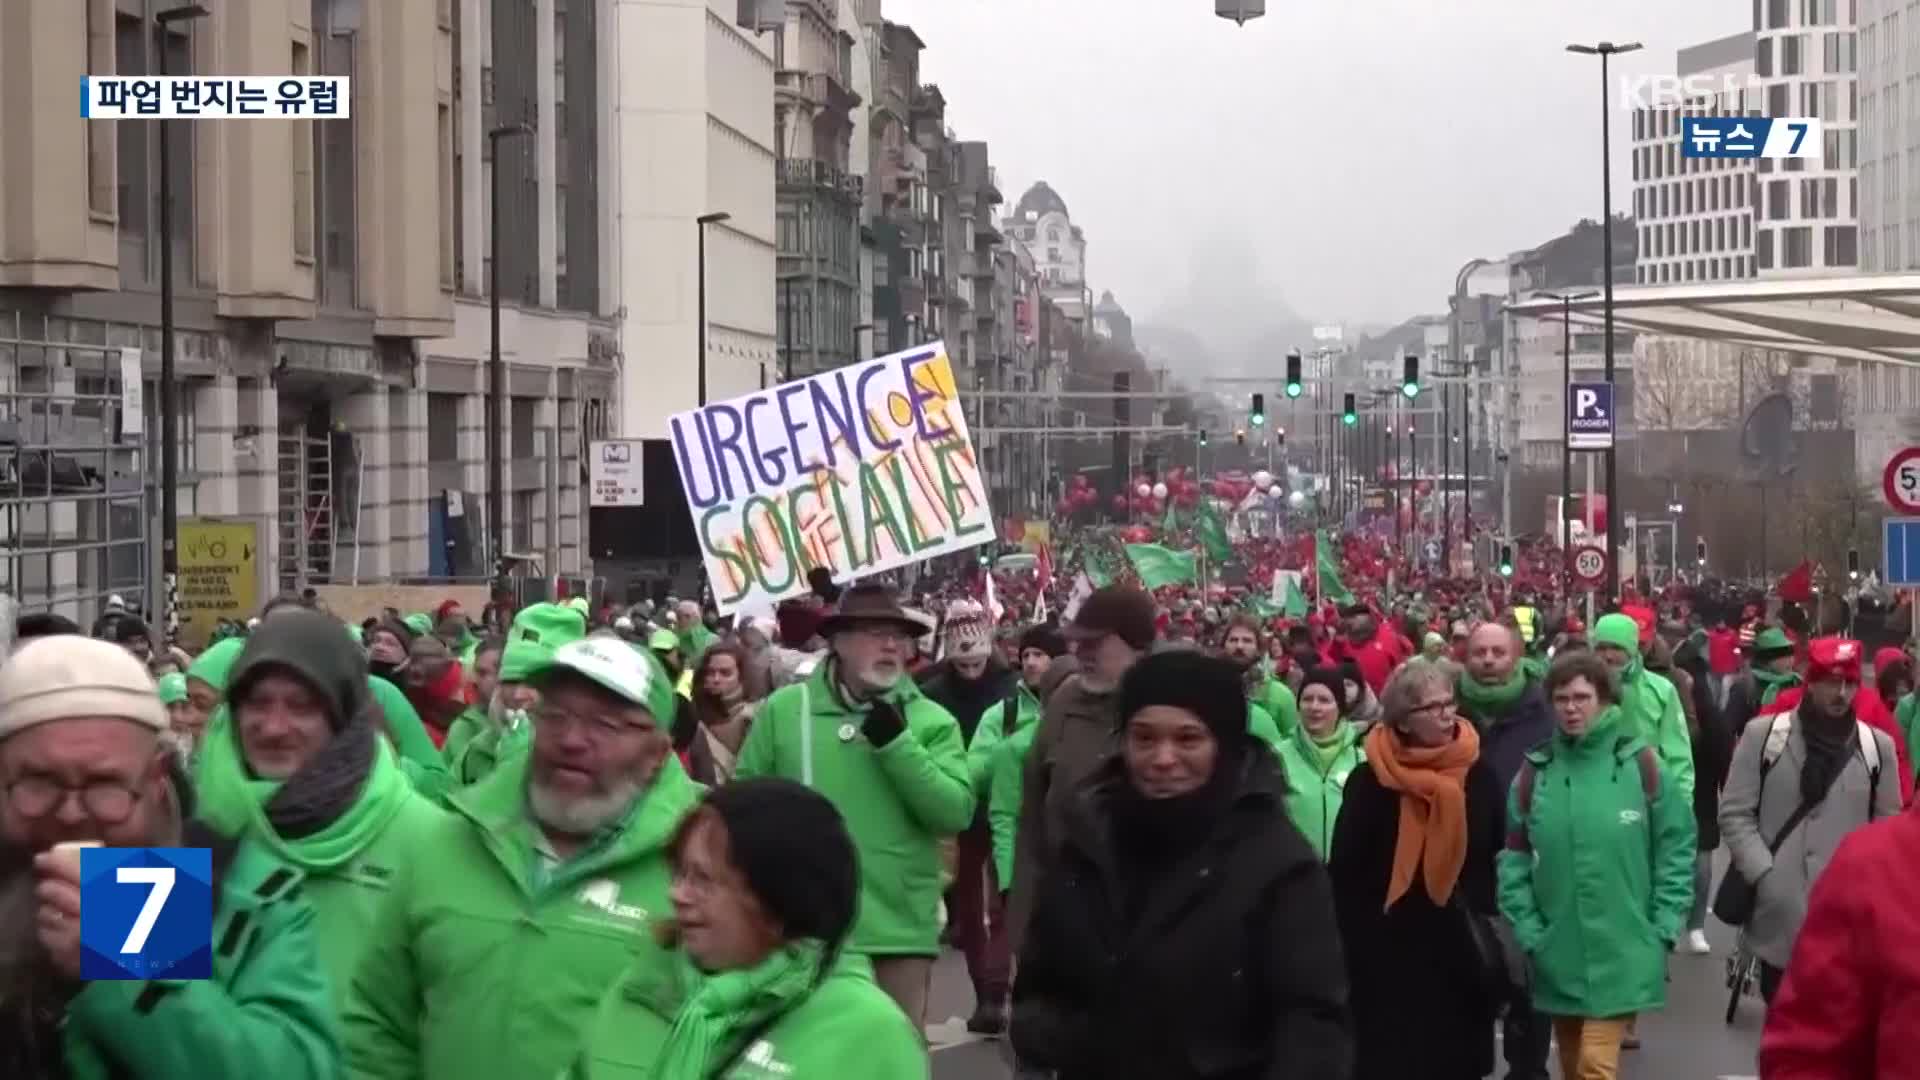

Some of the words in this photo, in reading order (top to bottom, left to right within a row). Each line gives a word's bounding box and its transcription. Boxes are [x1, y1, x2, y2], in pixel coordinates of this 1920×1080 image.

[671, 351, 951, 508] URGENCE
[1577, 389, 1597, 417] P
[700, 440, 986, 604] SOCIALE
[1580, 555, 1600, 569] 50
